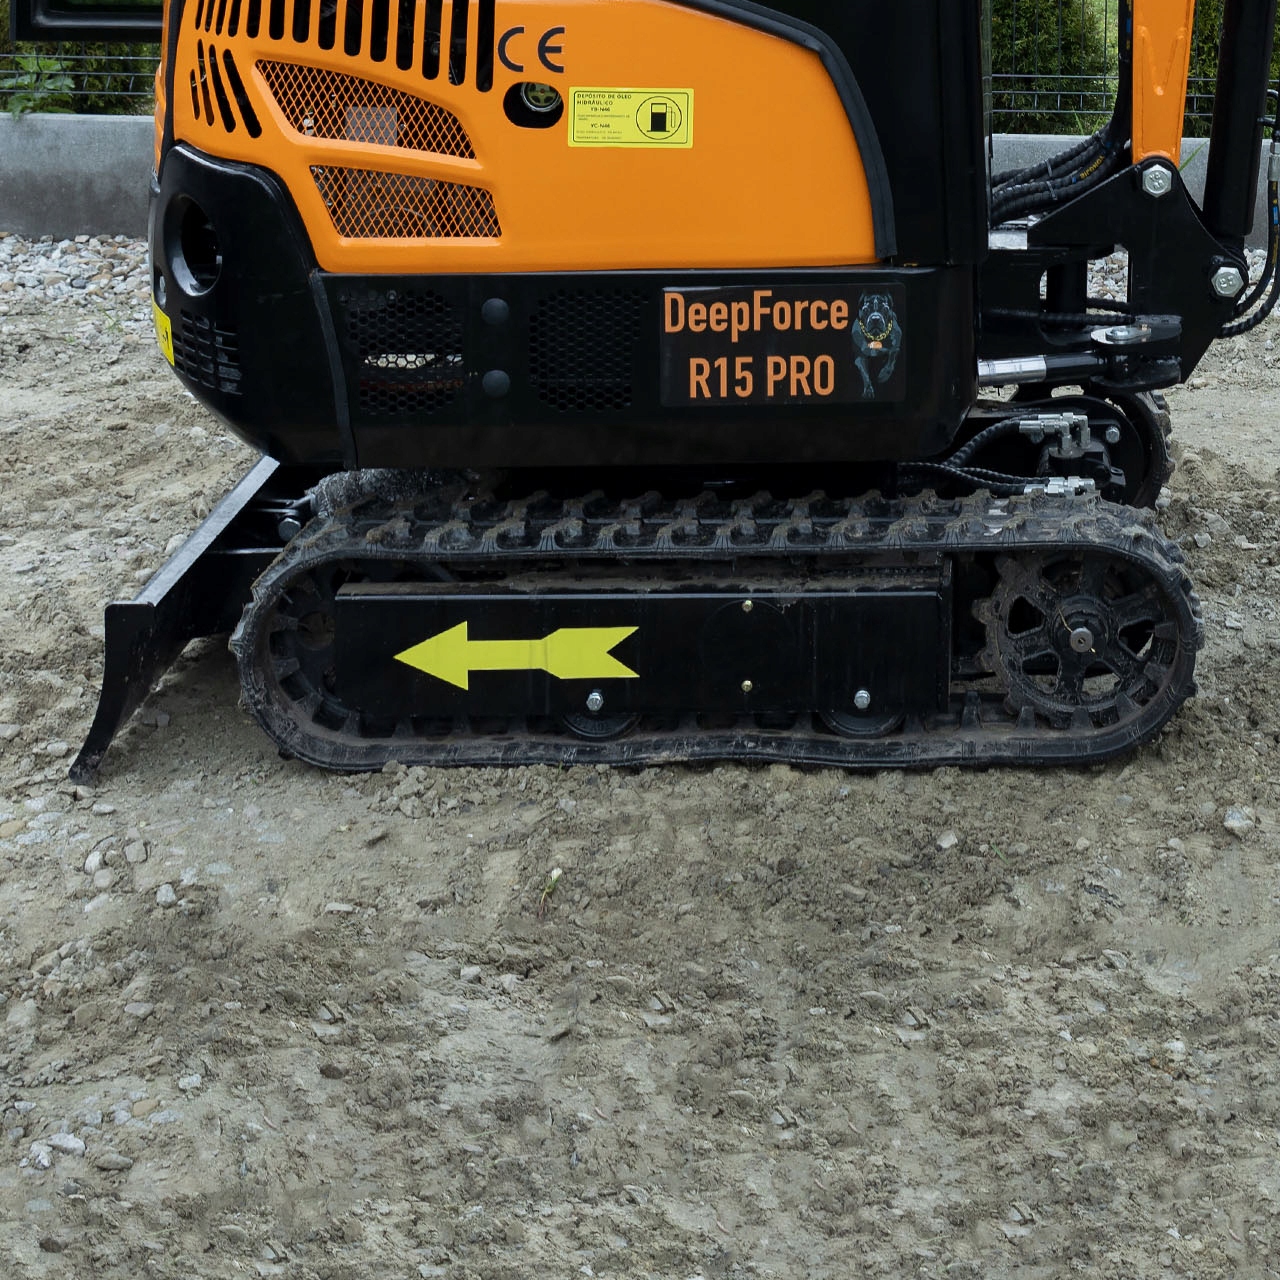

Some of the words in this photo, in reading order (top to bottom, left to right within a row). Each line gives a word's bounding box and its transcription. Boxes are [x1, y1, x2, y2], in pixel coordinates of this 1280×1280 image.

[664, 290, 849, 343] DeepForce
[689, 356, 753, 399] R15
[767, 354, 835, 397] PRO
